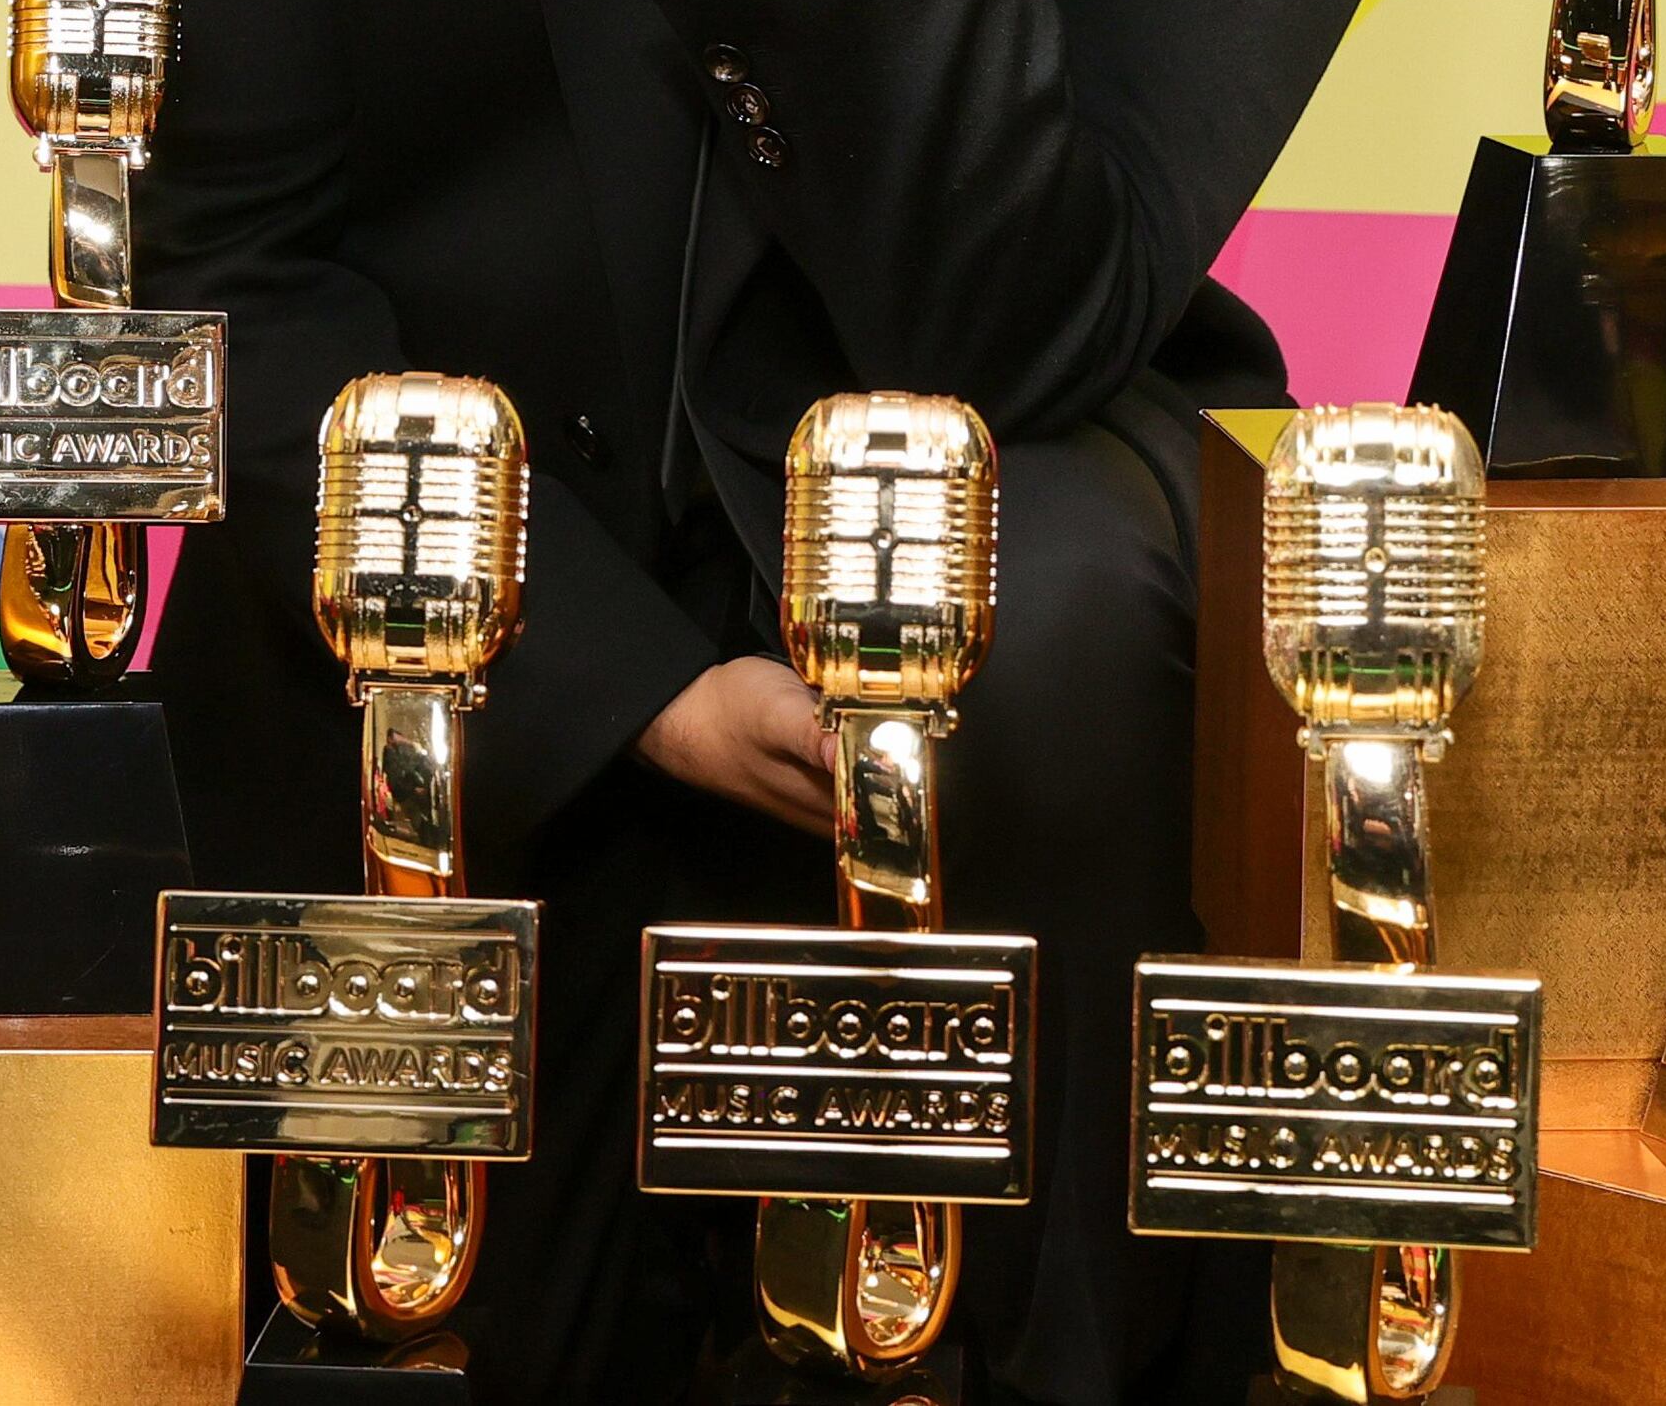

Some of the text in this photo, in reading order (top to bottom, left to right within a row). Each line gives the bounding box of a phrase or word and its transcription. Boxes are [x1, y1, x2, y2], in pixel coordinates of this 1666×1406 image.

[51, 432, 212, 466] AWARDS
[165, 934, 521, 1025] billboard
[655, 973, 1015, 1065] billboard
[163, 1040, 514, 1092] MUSIC AWARDS
[1148, 1012, 1519, 1110] billboard
[652, 1081, 1011, 1134] MUSIC AWARDS
[1310, 1130, 1517, 1182] AWARDS
